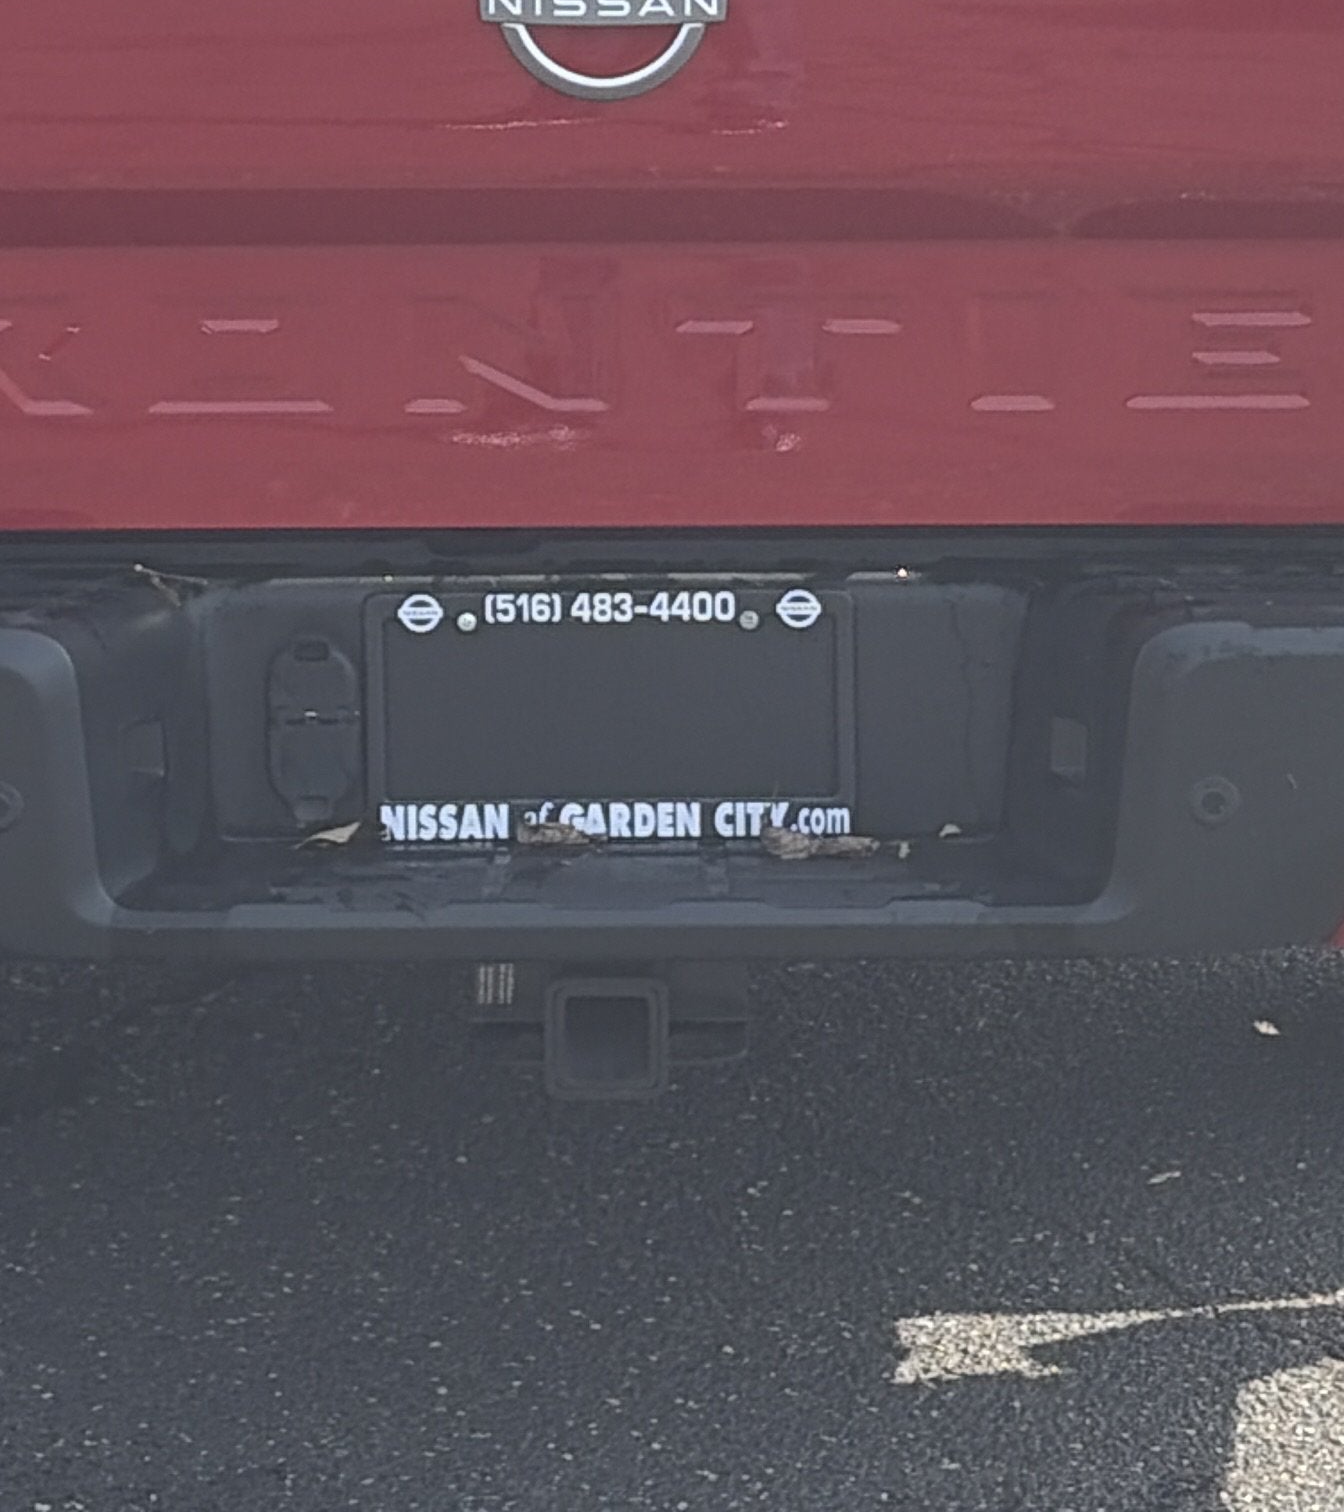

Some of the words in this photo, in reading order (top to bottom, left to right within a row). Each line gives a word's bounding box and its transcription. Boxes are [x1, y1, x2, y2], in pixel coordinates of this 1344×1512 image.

[484, 592, 562, 624] (516)
[570, 590, 736, 623] 483-4400
[379, 803, 510, 841] NISSAN
[558, 801, 702, 840] GARDEN
